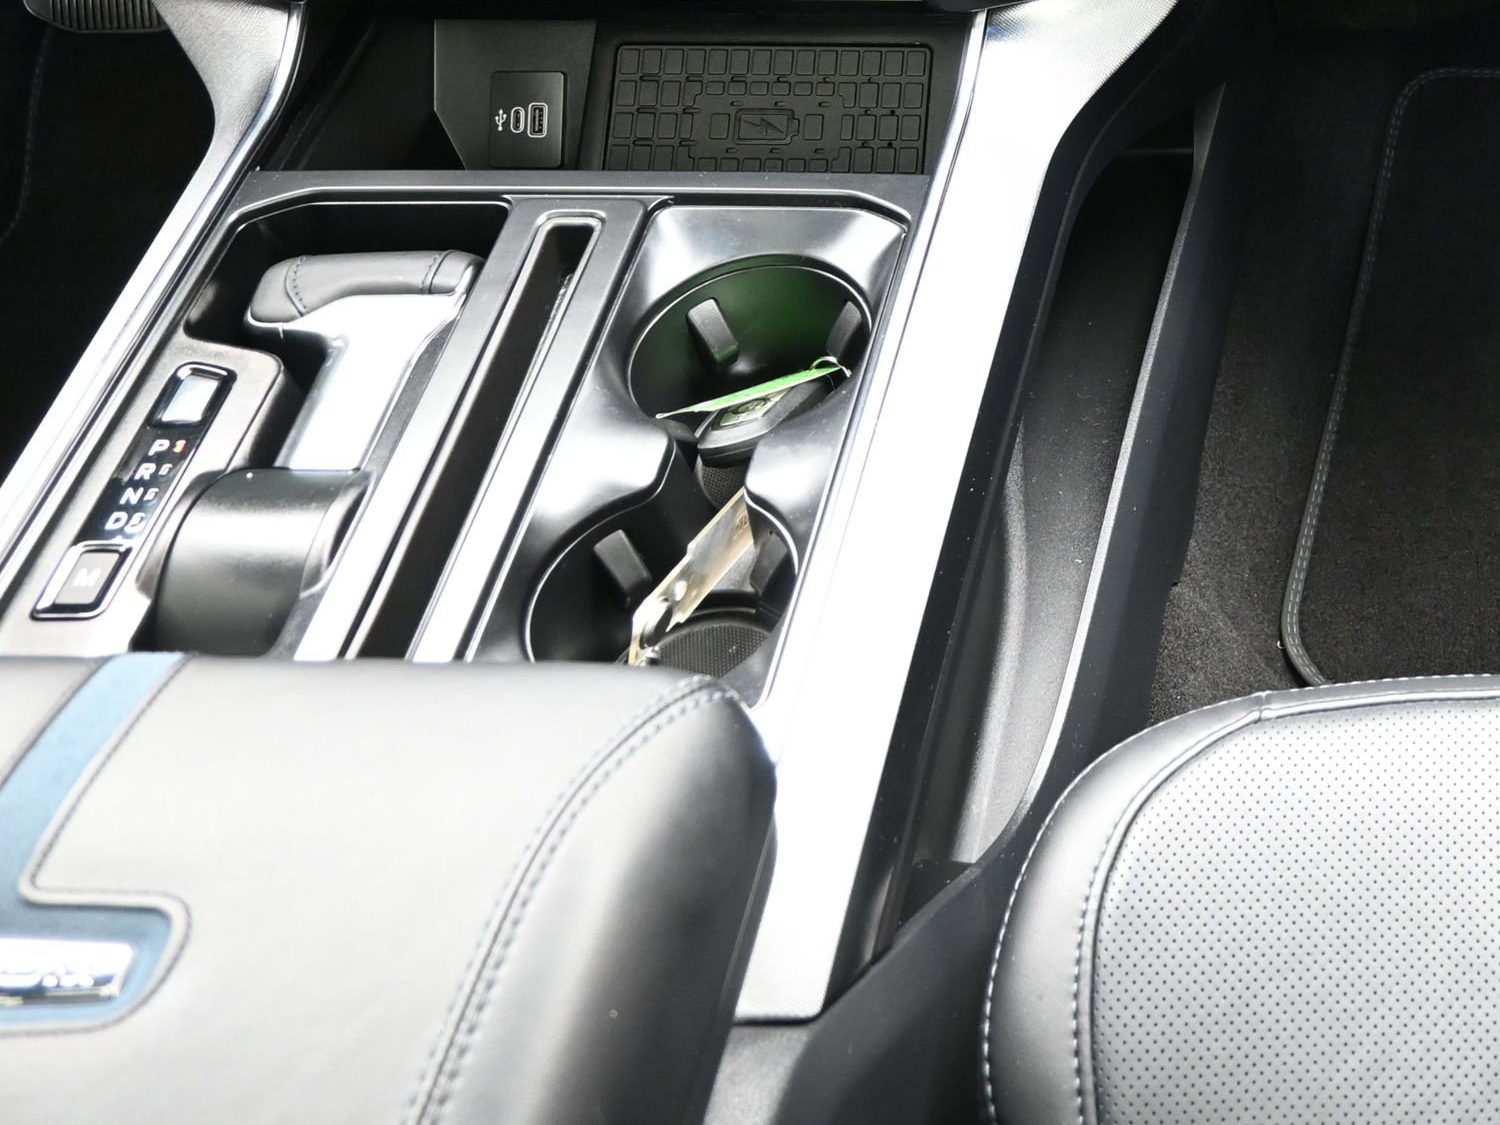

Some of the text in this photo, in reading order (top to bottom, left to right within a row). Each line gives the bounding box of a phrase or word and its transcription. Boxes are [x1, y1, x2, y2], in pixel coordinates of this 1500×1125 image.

[148, 439, 170, 456] P
[134, 463, 156, 481] R
[119, 486, 144, 505] N
[104, 511, 128, 531] D
[73, 567, 101, 587] M
